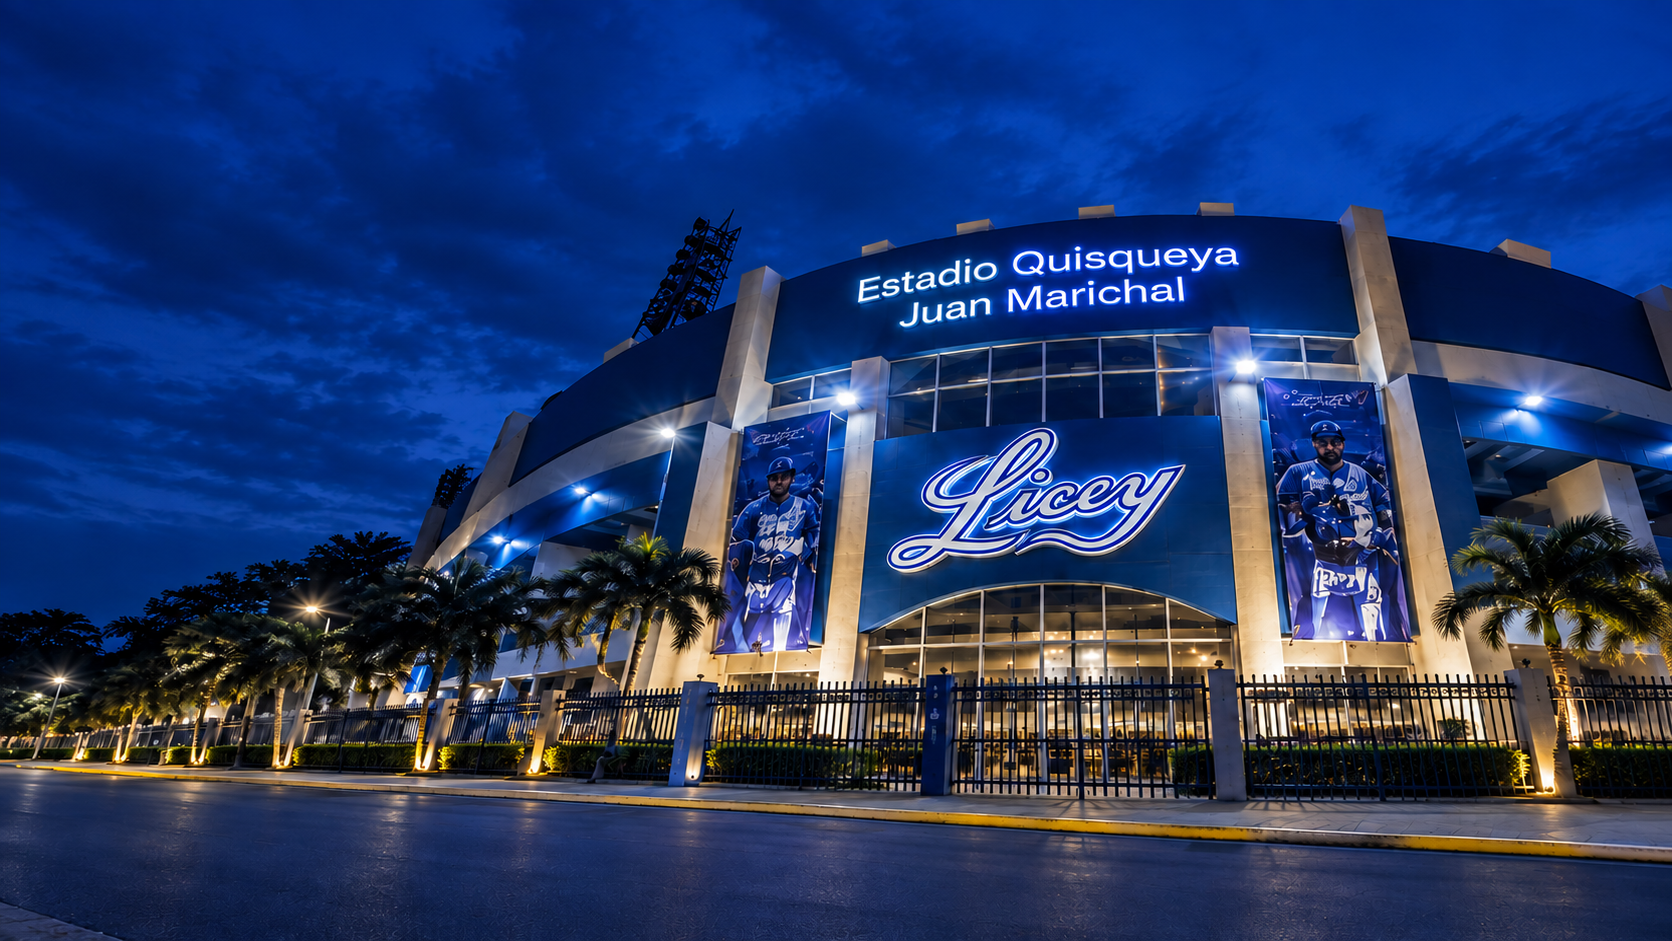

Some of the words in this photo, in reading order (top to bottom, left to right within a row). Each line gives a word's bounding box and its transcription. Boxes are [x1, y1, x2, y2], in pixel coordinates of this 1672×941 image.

[857, 257, 999, 303] Estadio
[1011, 245, 1240, 276] Quisqueya
[898, 296, 992, 329] Juan
[1007, 276, 1186, 313] Marichal
[887, 427, 1186, 573] Licey
